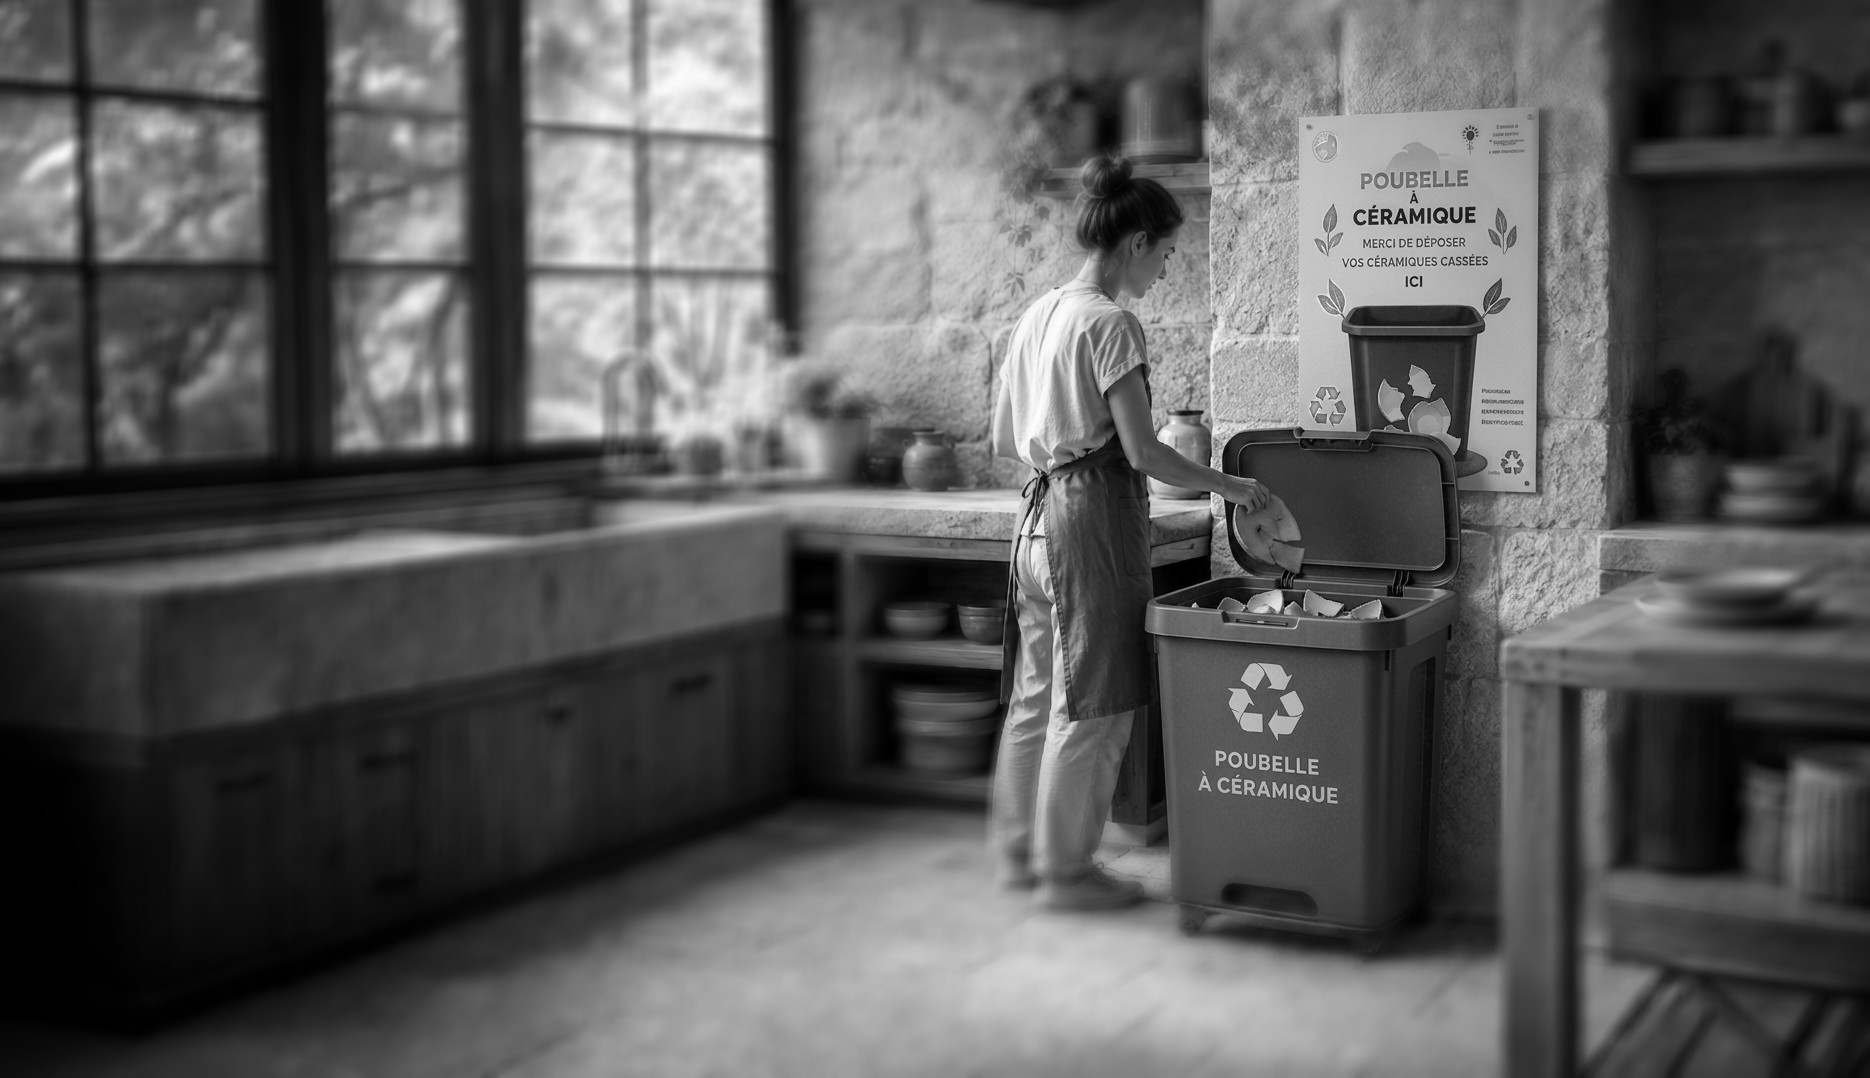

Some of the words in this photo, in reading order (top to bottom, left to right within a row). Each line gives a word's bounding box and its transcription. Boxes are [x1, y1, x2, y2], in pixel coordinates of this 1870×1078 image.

[1360, 169, 1469, 190] POUBELLE
[1353, 205, 1476, 226] CÉRAMIQUE
[1362, 238, 1396, 248] MERCI
[1399, 238, 1413, 248] DE
[1416, 236, 1466, 248] DÉPOSER
[1342, 257, 1364, 268] VOS
[1366, 255, 1438, 267] CÉRAMIQUES
[1440, 254, 1489, 266] CASSÉES
[1405, 275, 1423, 288] ICI
[1215, 750, 1320, 776] POUBELLE
[1198, 770, 1212, 792] À
[1217, 774, 1339, 805] CÉRAMIQUE
